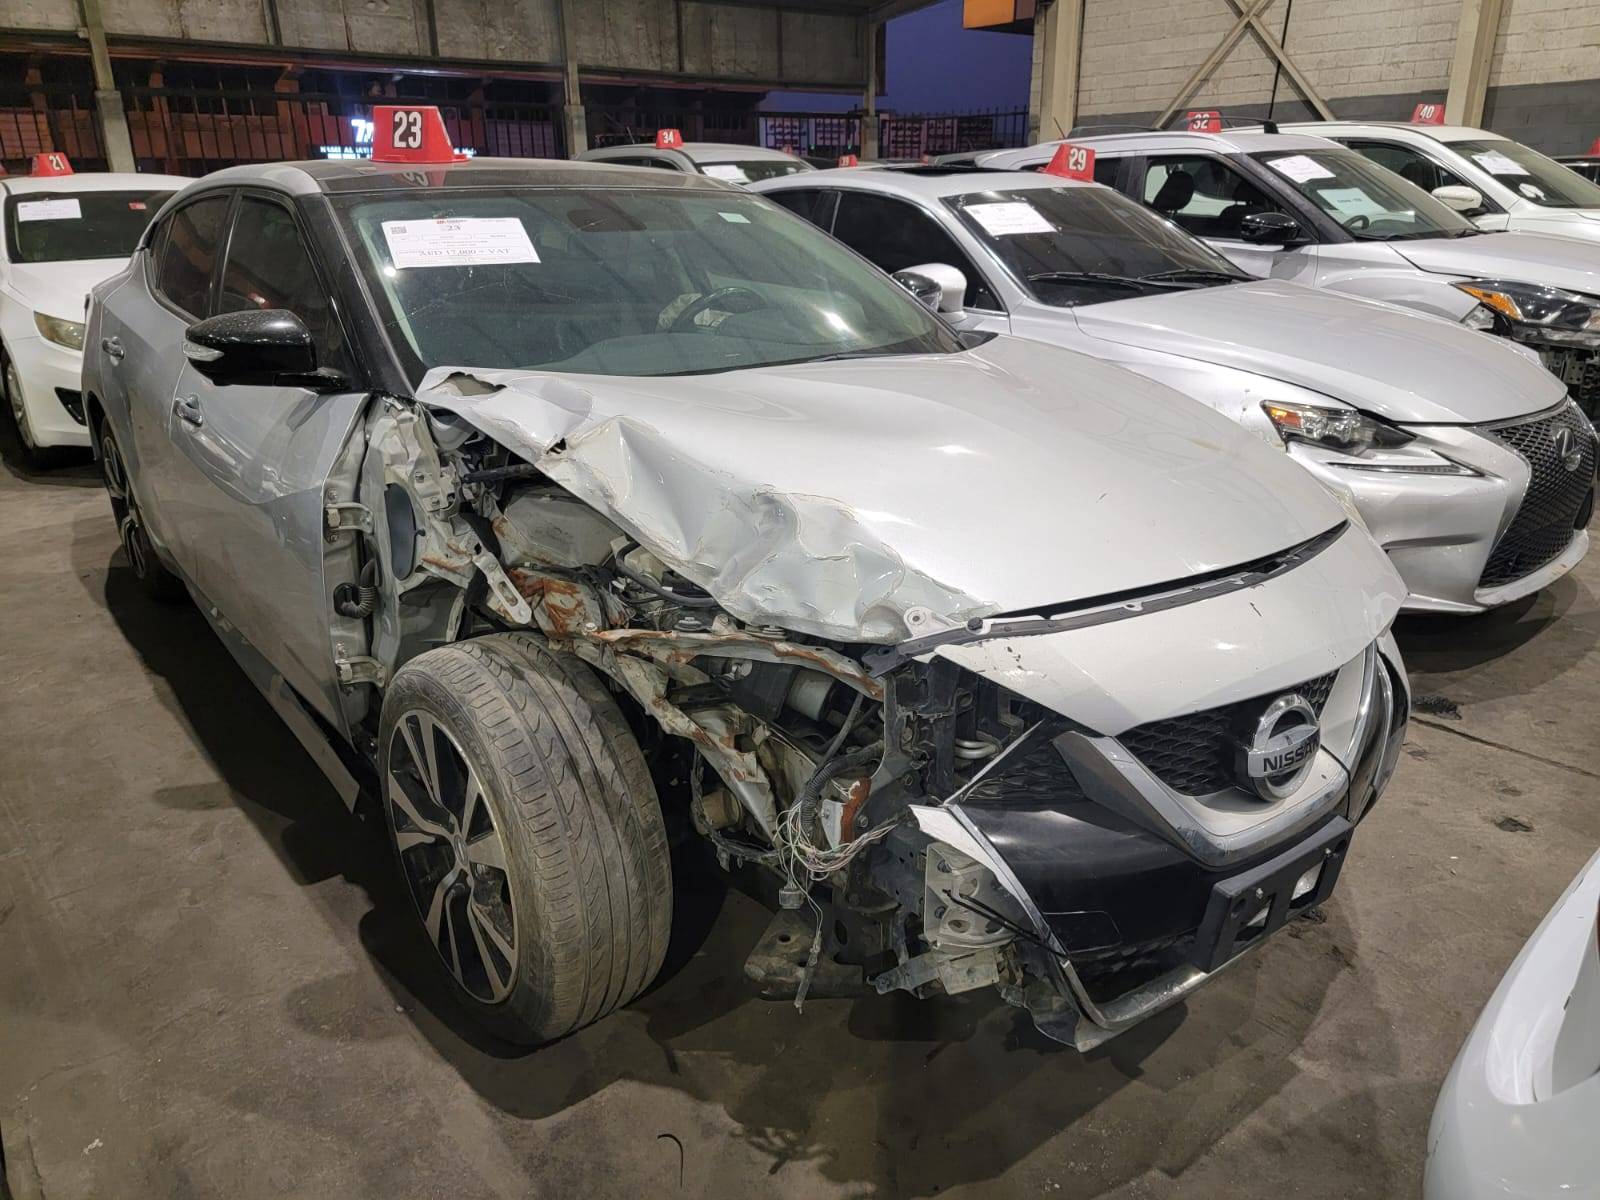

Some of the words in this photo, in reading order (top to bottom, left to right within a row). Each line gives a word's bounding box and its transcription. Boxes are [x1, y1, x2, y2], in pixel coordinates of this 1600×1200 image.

[1420, 105, 1435, 119] 40
[1192, 113, 1210, 130] 32
[394, 111, 422, 149] 23
[663, 131, 674, 144] 34
[49, 155, 65, 171] 21
[1069, 148, 1087, 171] 29
